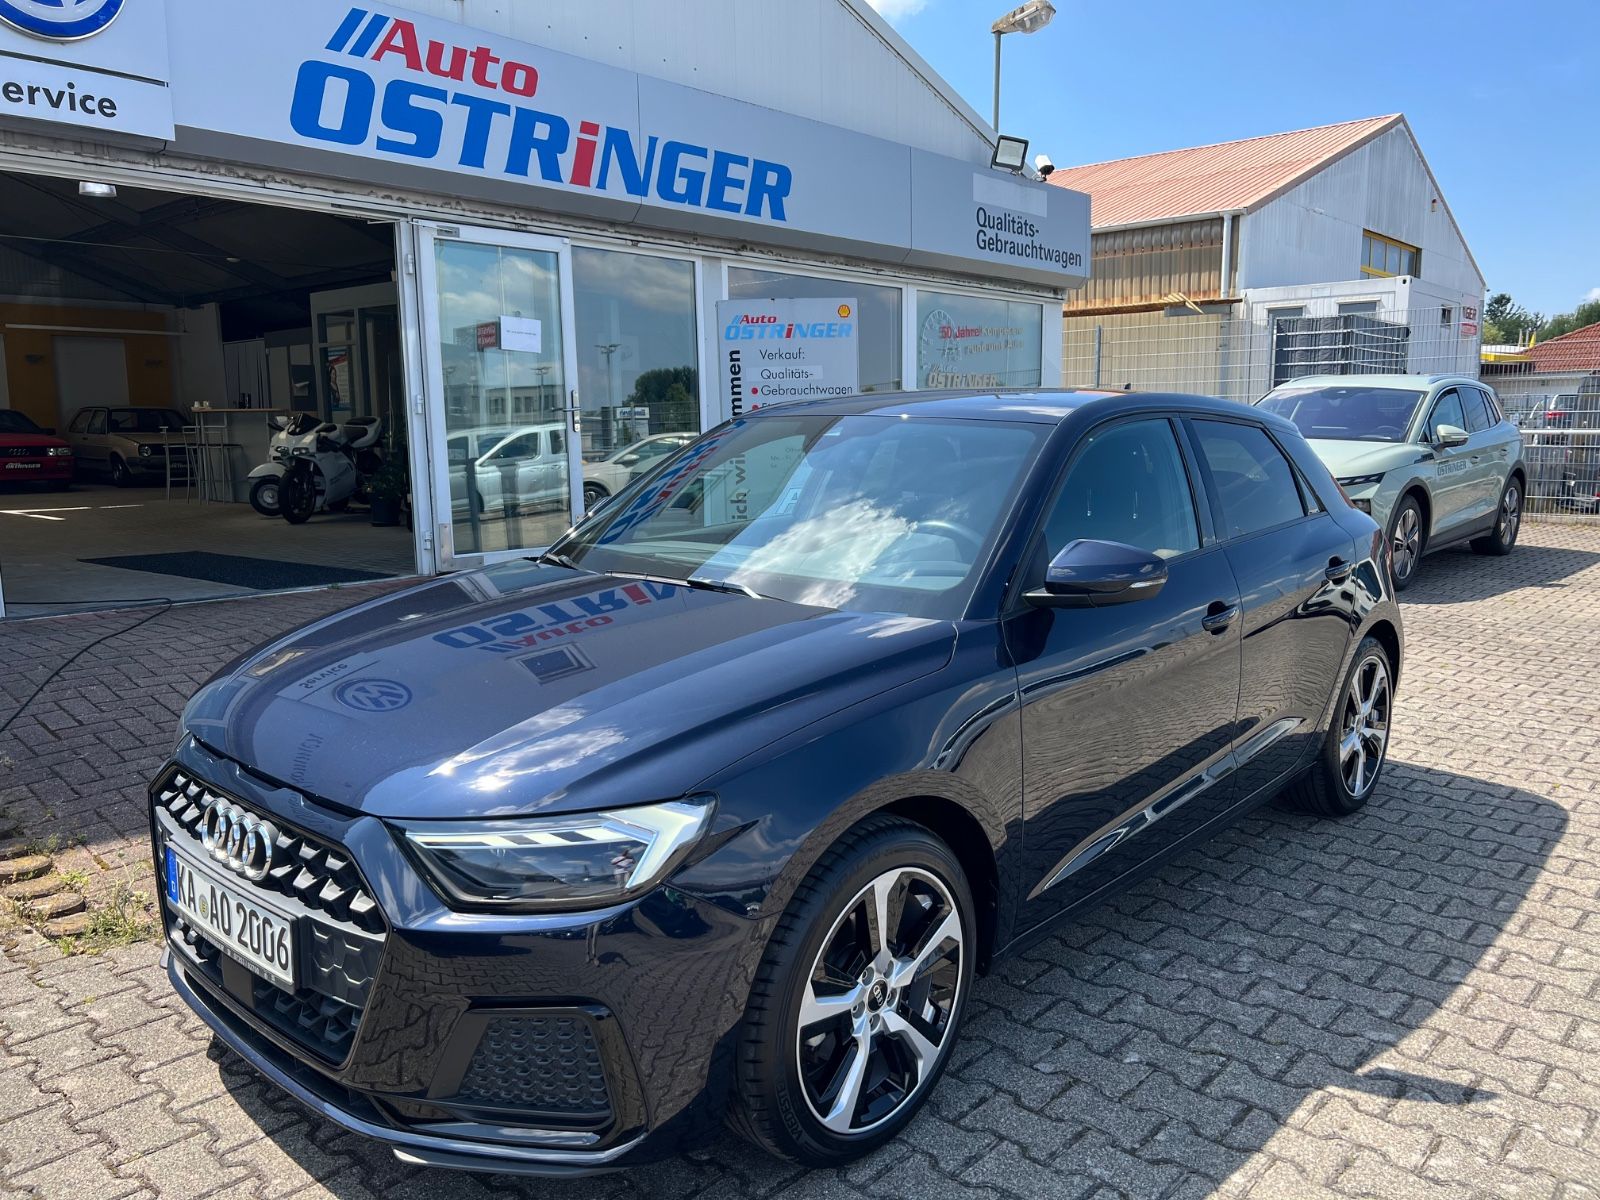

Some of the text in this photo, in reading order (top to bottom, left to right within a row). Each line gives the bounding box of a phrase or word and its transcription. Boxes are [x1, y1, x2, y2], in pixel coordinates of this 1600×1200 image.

[371, 17, 539, 98] Auto
[1, 81, 117, 118] ervice
[976, 206, 1040, 238] Qualitäts-
[976, 229, 1082, 269] Gebrauchtwagen
[740, 314, 777, 325] Auto
[759, 347, 806, 360] Verkauf:
[760, 368, 814, 380] Qualitäts-
[176, 859, 197, 913] KA
[209, 883, 232, 937] AO
[235, 901, 290, 972] 2006
